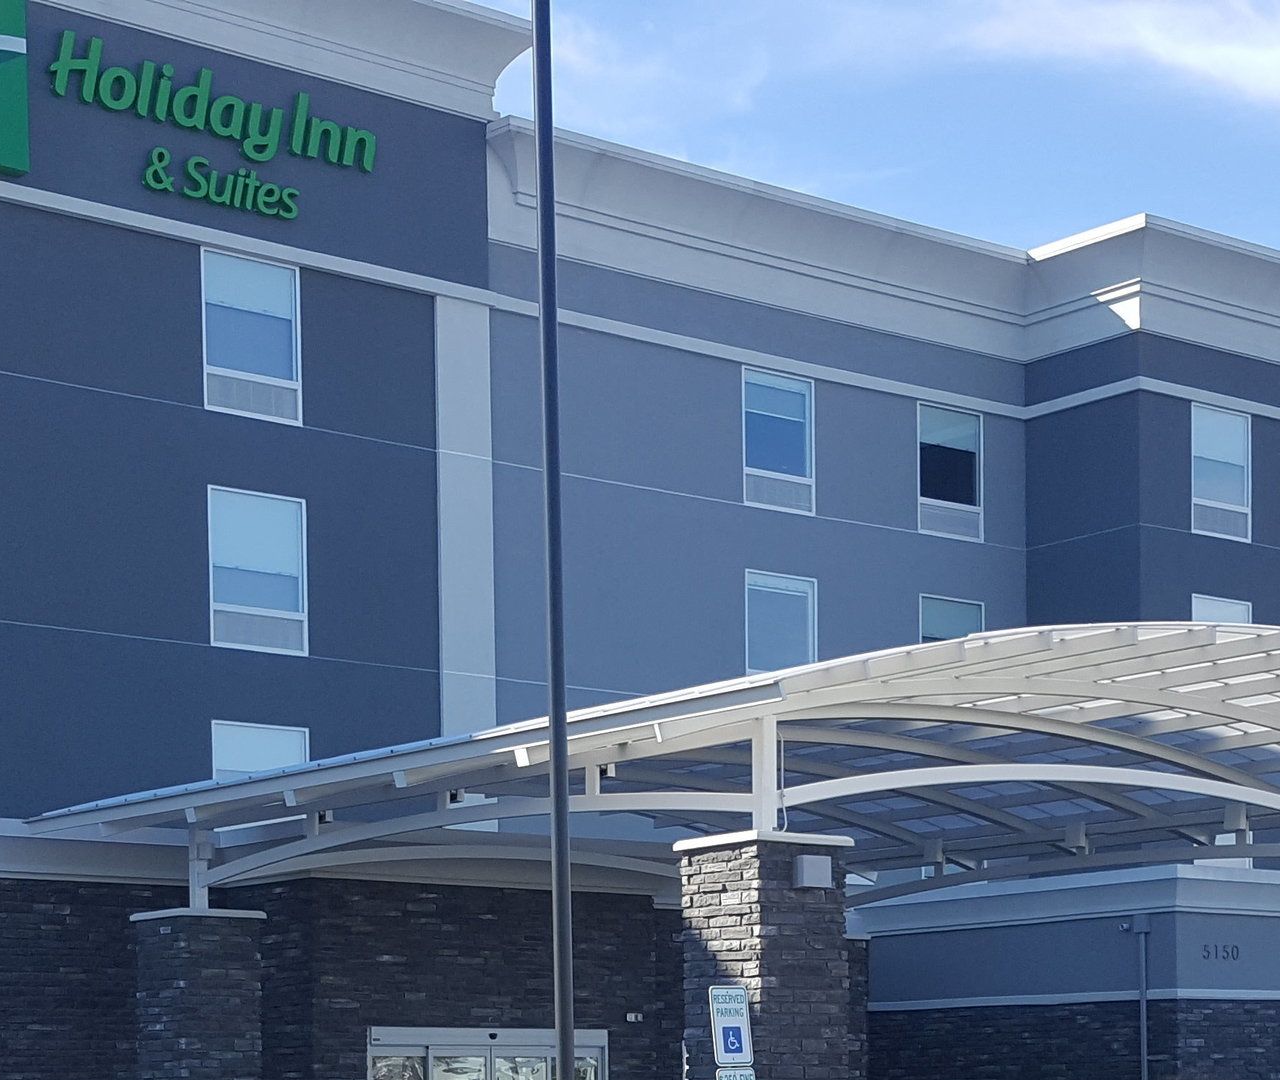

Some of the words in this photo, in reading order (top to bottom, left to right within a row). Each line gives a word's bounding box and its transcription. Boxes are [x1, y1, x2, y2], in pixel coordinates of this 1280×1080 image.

[50, 30, 283, 162] Holiday
[291, 92, 377, 173] Inn
[142, 146, 173, 192] &
[182, 155, 300, 220] Suites
[1202, 944, 1240, 961] 5150
[713, 994, 745, 1005] RESERVED
[716, 1008, 744, 1018] PARKING
